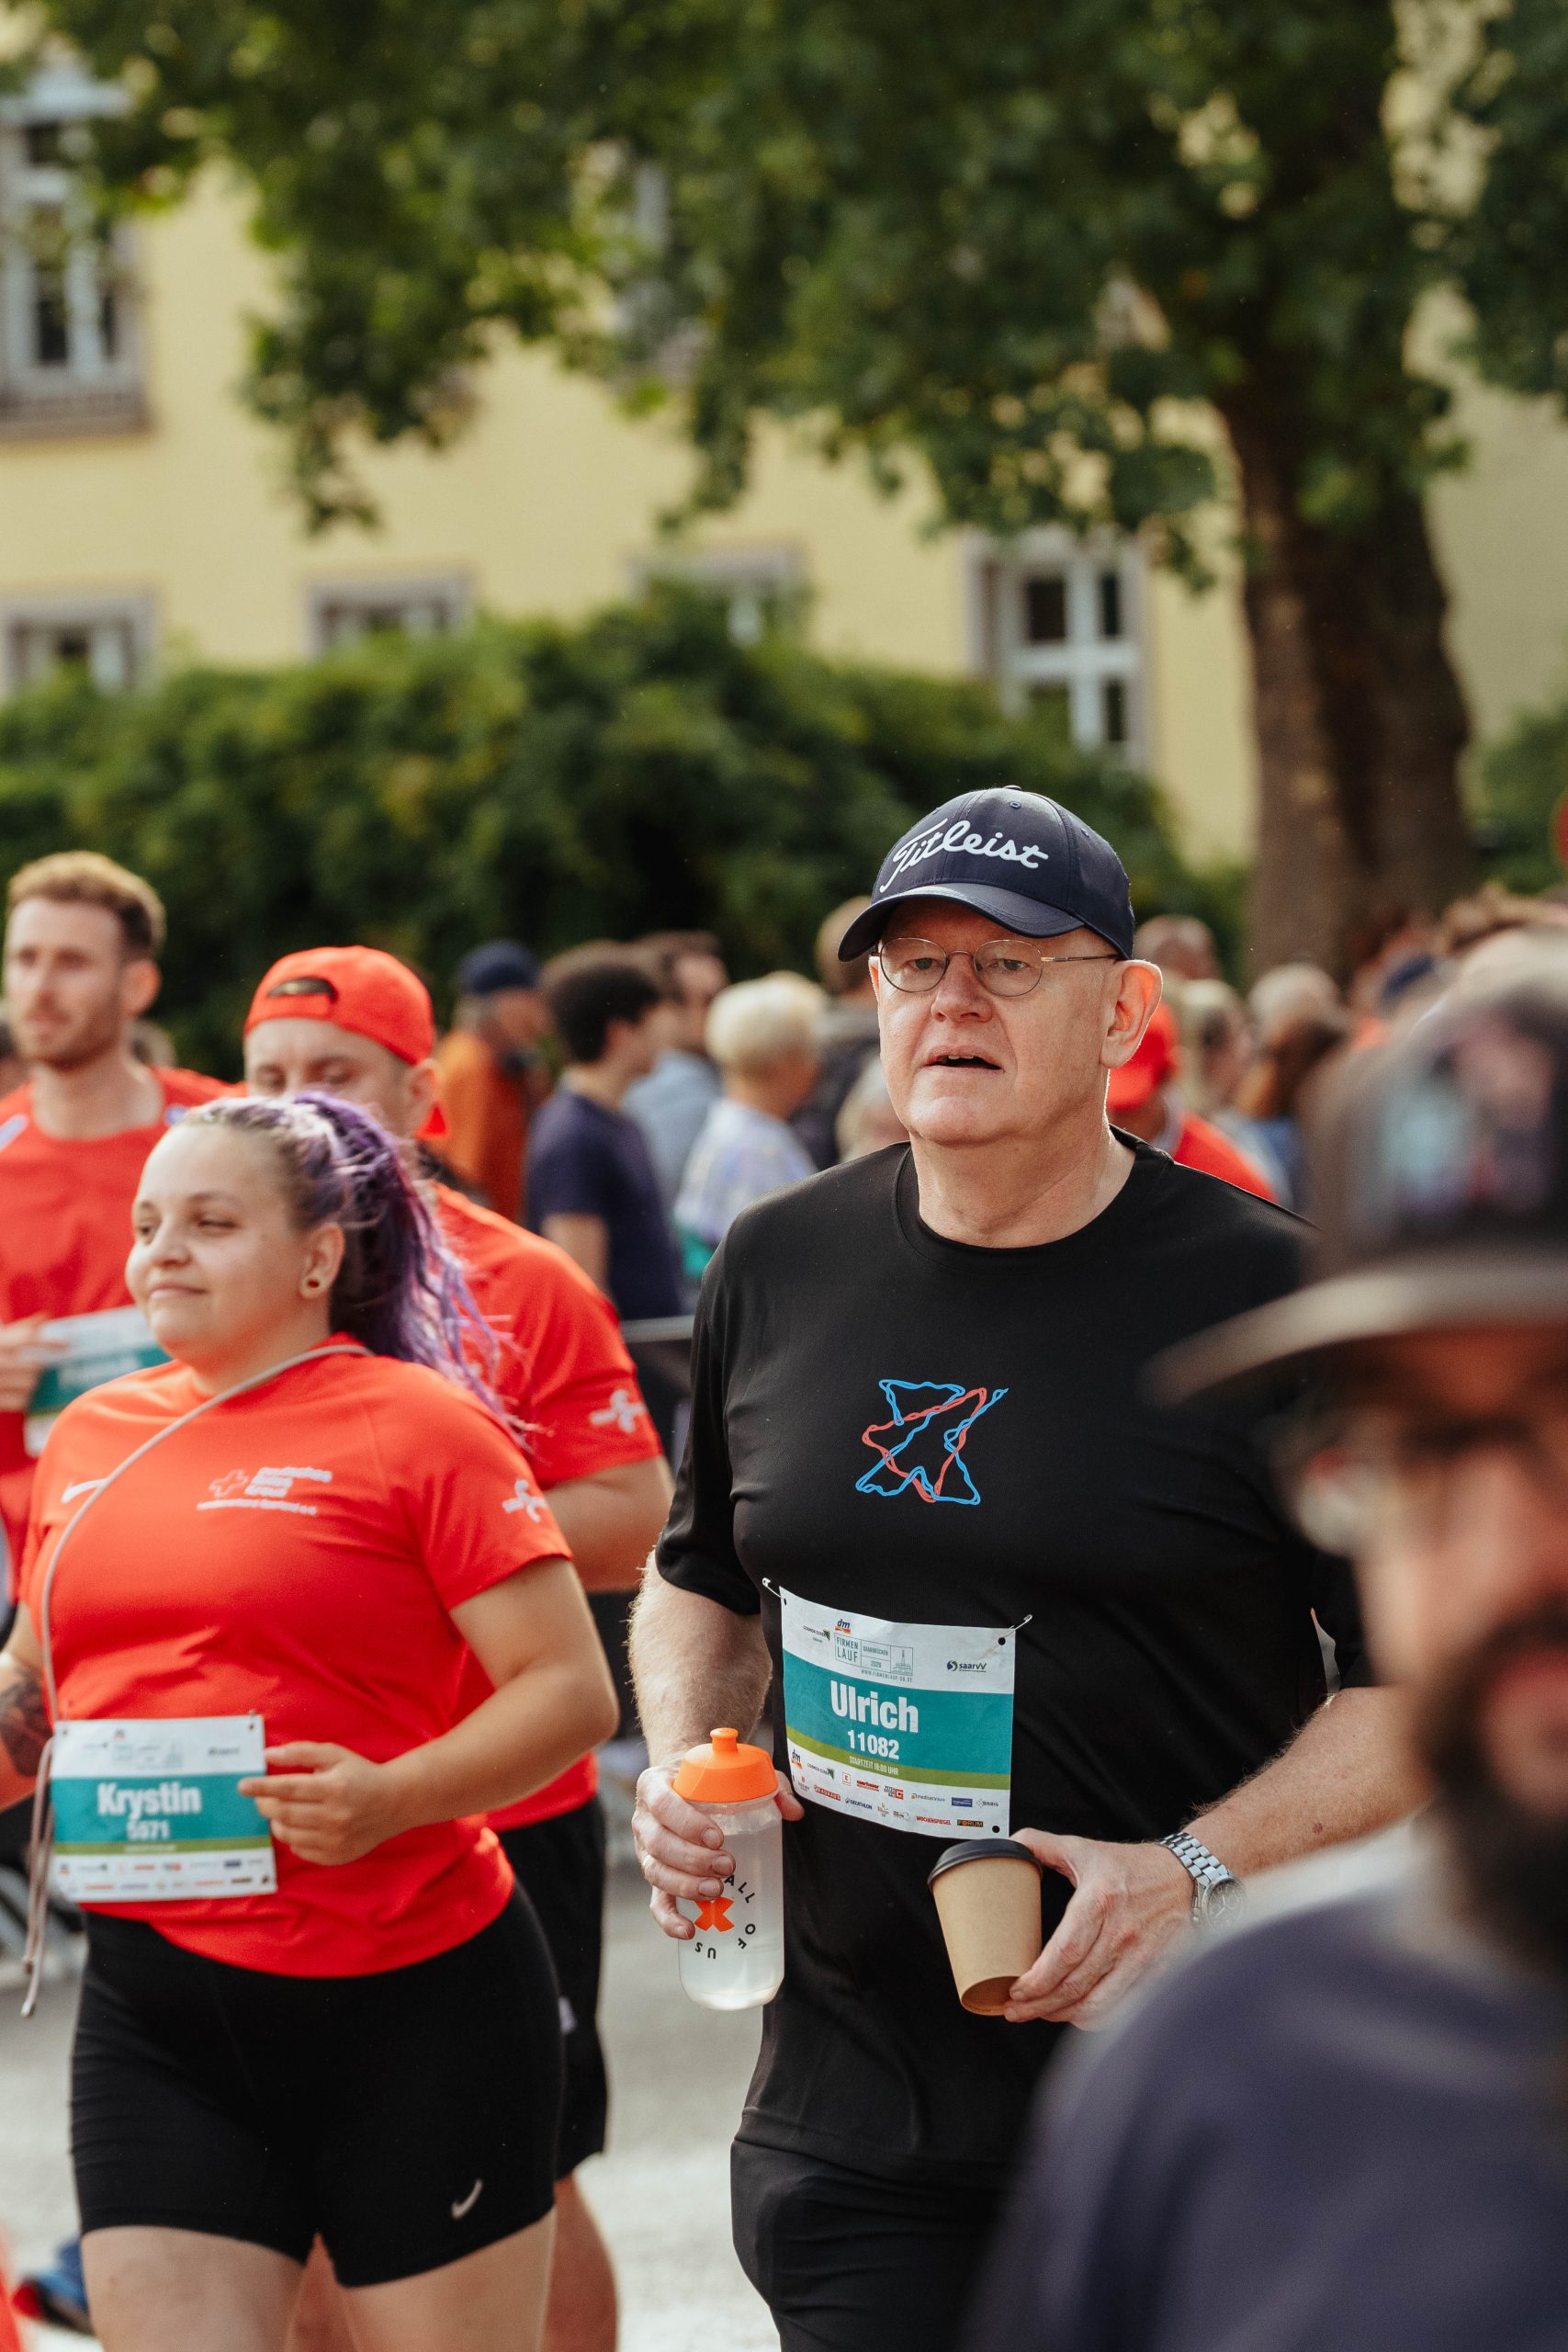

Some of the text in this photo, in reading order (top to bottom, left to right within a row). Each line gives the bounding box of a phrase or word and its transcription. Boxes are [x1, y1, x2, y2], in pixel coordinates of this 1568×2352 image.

[880, 818, 1049, 893] Titleist
[837, 1619, 851, 1629] dm
[837, 1636, 859, 1650] FIRMEN
[837, 1647, 858, 1663] LAUF
[830, 1680, 919, 1733] Ulrich
[847, 1729, 899, 1759] 11082
[792, 1749, 801, 1762] dm
[887, 1766, 899, 1775] UHR
[97, 1781, 202, 1820] Krystin
[850, 1799, 873, 1810] DECATHLON
[916, 1815, 952, 1826] WOCHENSPIEGEL
[694, 1874, 756, 1960] ALL OF US
